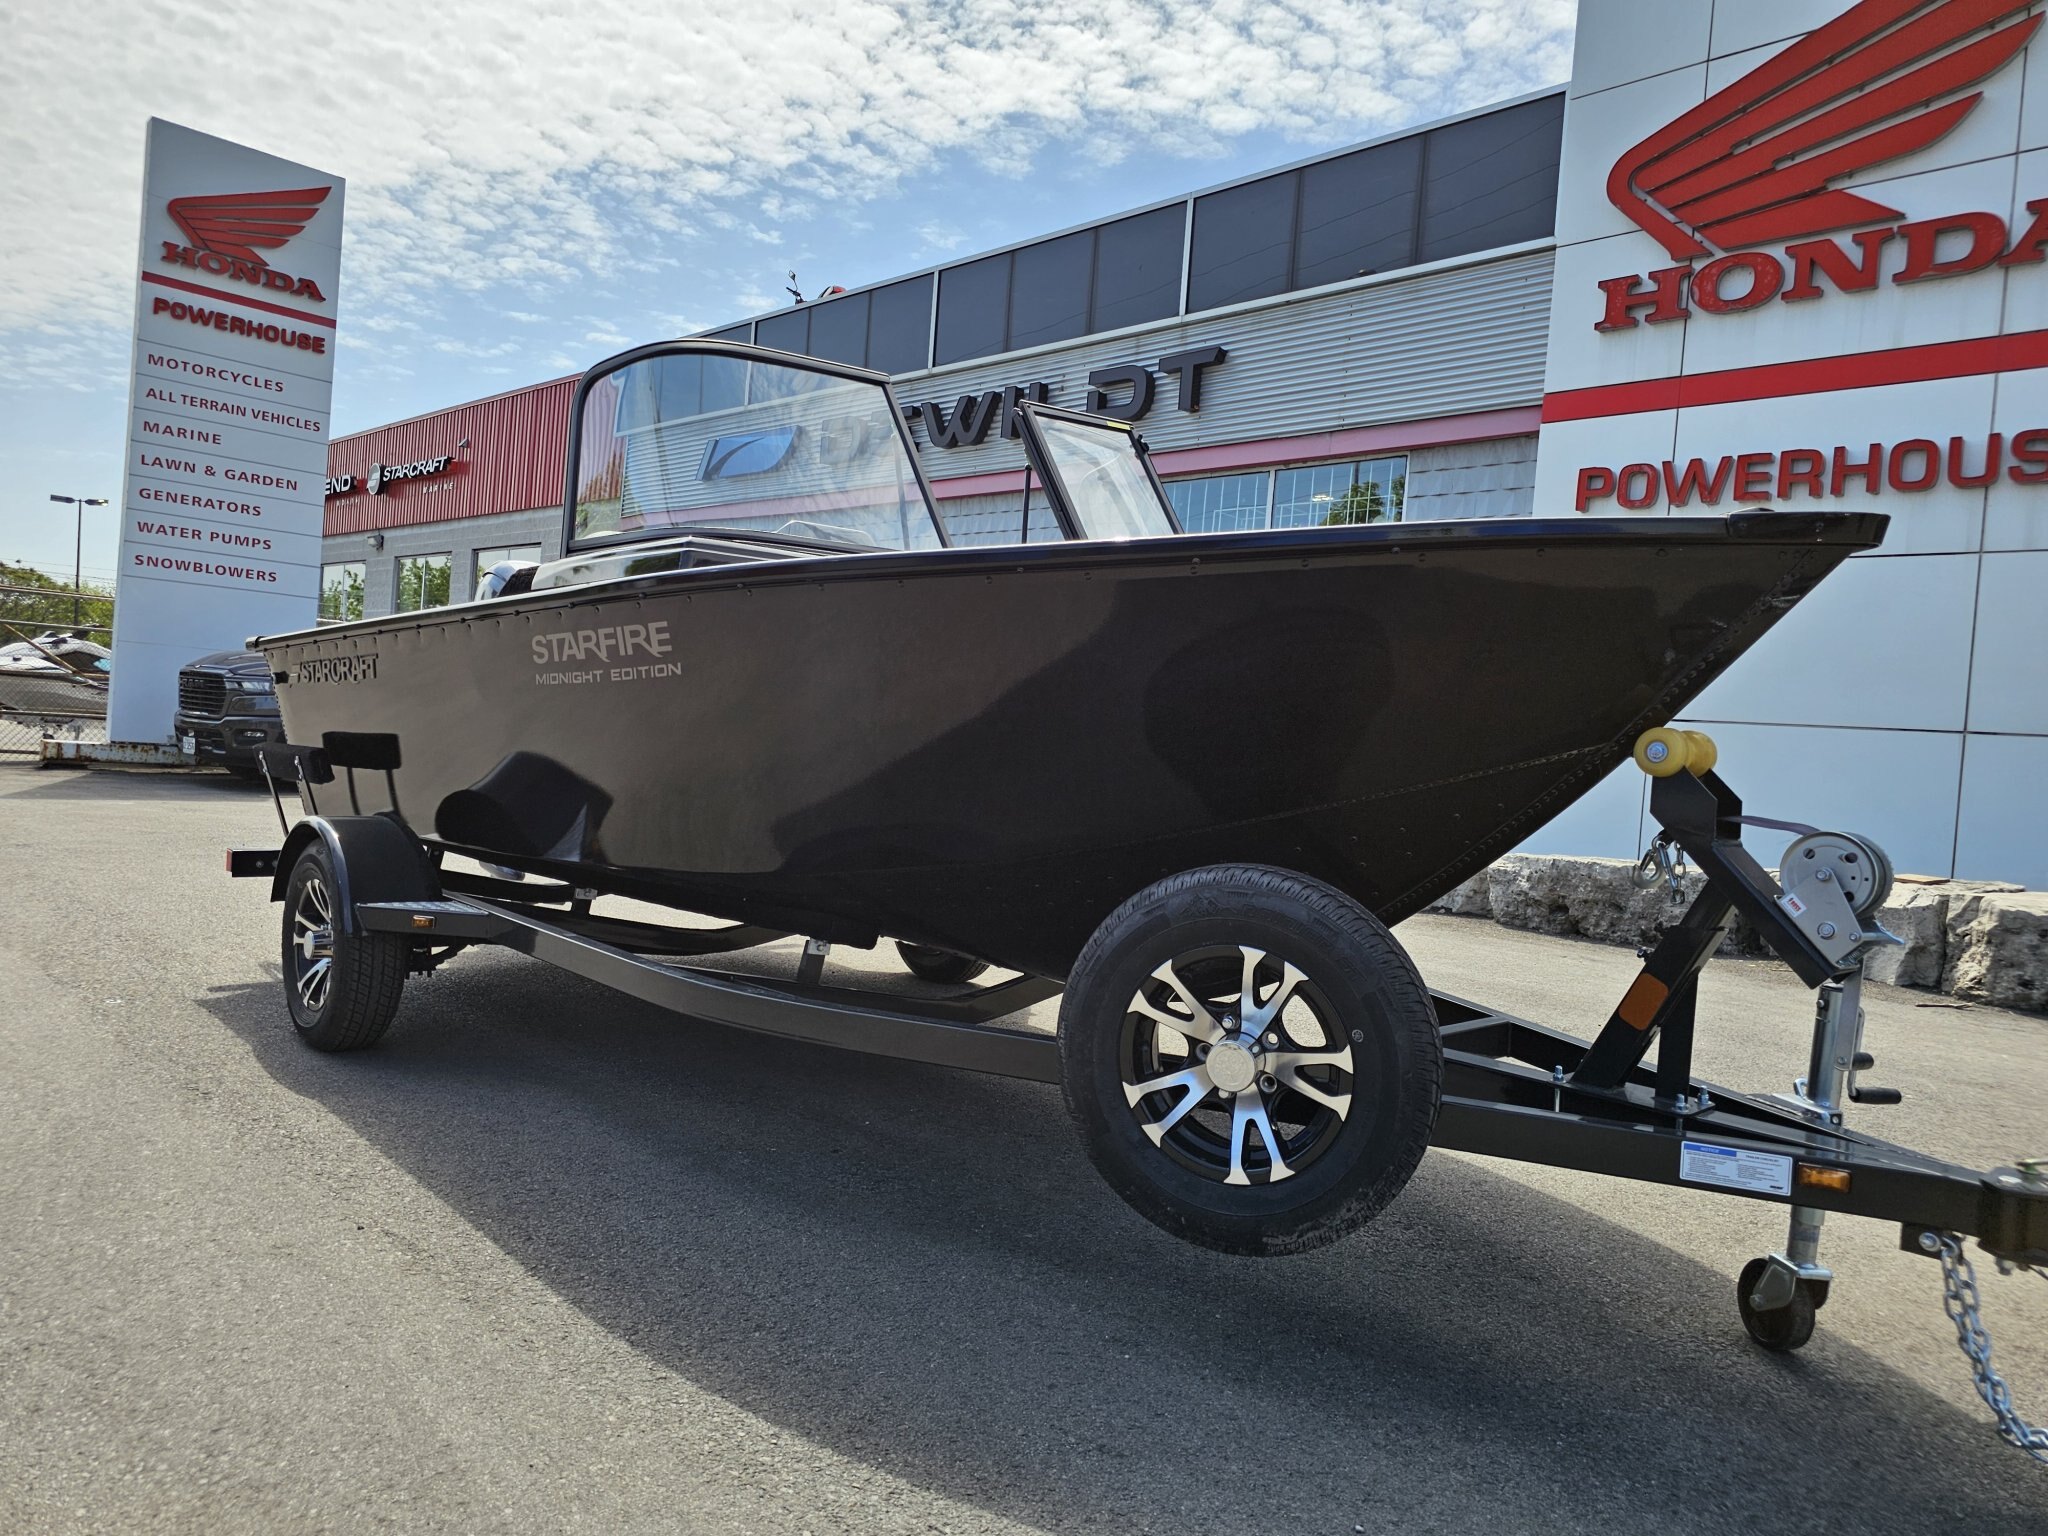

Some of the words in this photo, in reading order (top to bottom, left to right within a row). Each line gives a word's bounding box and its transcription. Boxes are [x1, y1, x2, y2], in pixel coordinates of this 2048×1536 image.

[160, 241, 326, 302] HONDA
[153, 297, 326, 354] POWERHOUSE
[147, 353, 284, 393] MOTORCYCLES
[145, 387, 177, 404] ALL
[180, 393, 247, 417] TERRAIN
[251, 408, 321, 432] VEHICLES
[143, 420, 222, 445] MARINE
[140, 454, 196, 474] LAWN
[204, 465, 216, 477] &
[224, 469, 298, 491] GARDEN
[383, 456, 448, 482] STARCRAFT
[1575, 428, 2048, 513] POWERHOUS
[138, 487, 262, 517] GENERATORS
[137, 521, 202, 540] WATER
[209, 531, 272, 550] PUMPS
[134, 554, 277, 583] SNOWBLOWERS
[531, 621, 672, 664] STARFIRE
[300, 653, 379, 685] STARCRAFT
[535, 669, 604, 685] MIDNIGHT
[610, 662, 682, 682] EDITION
